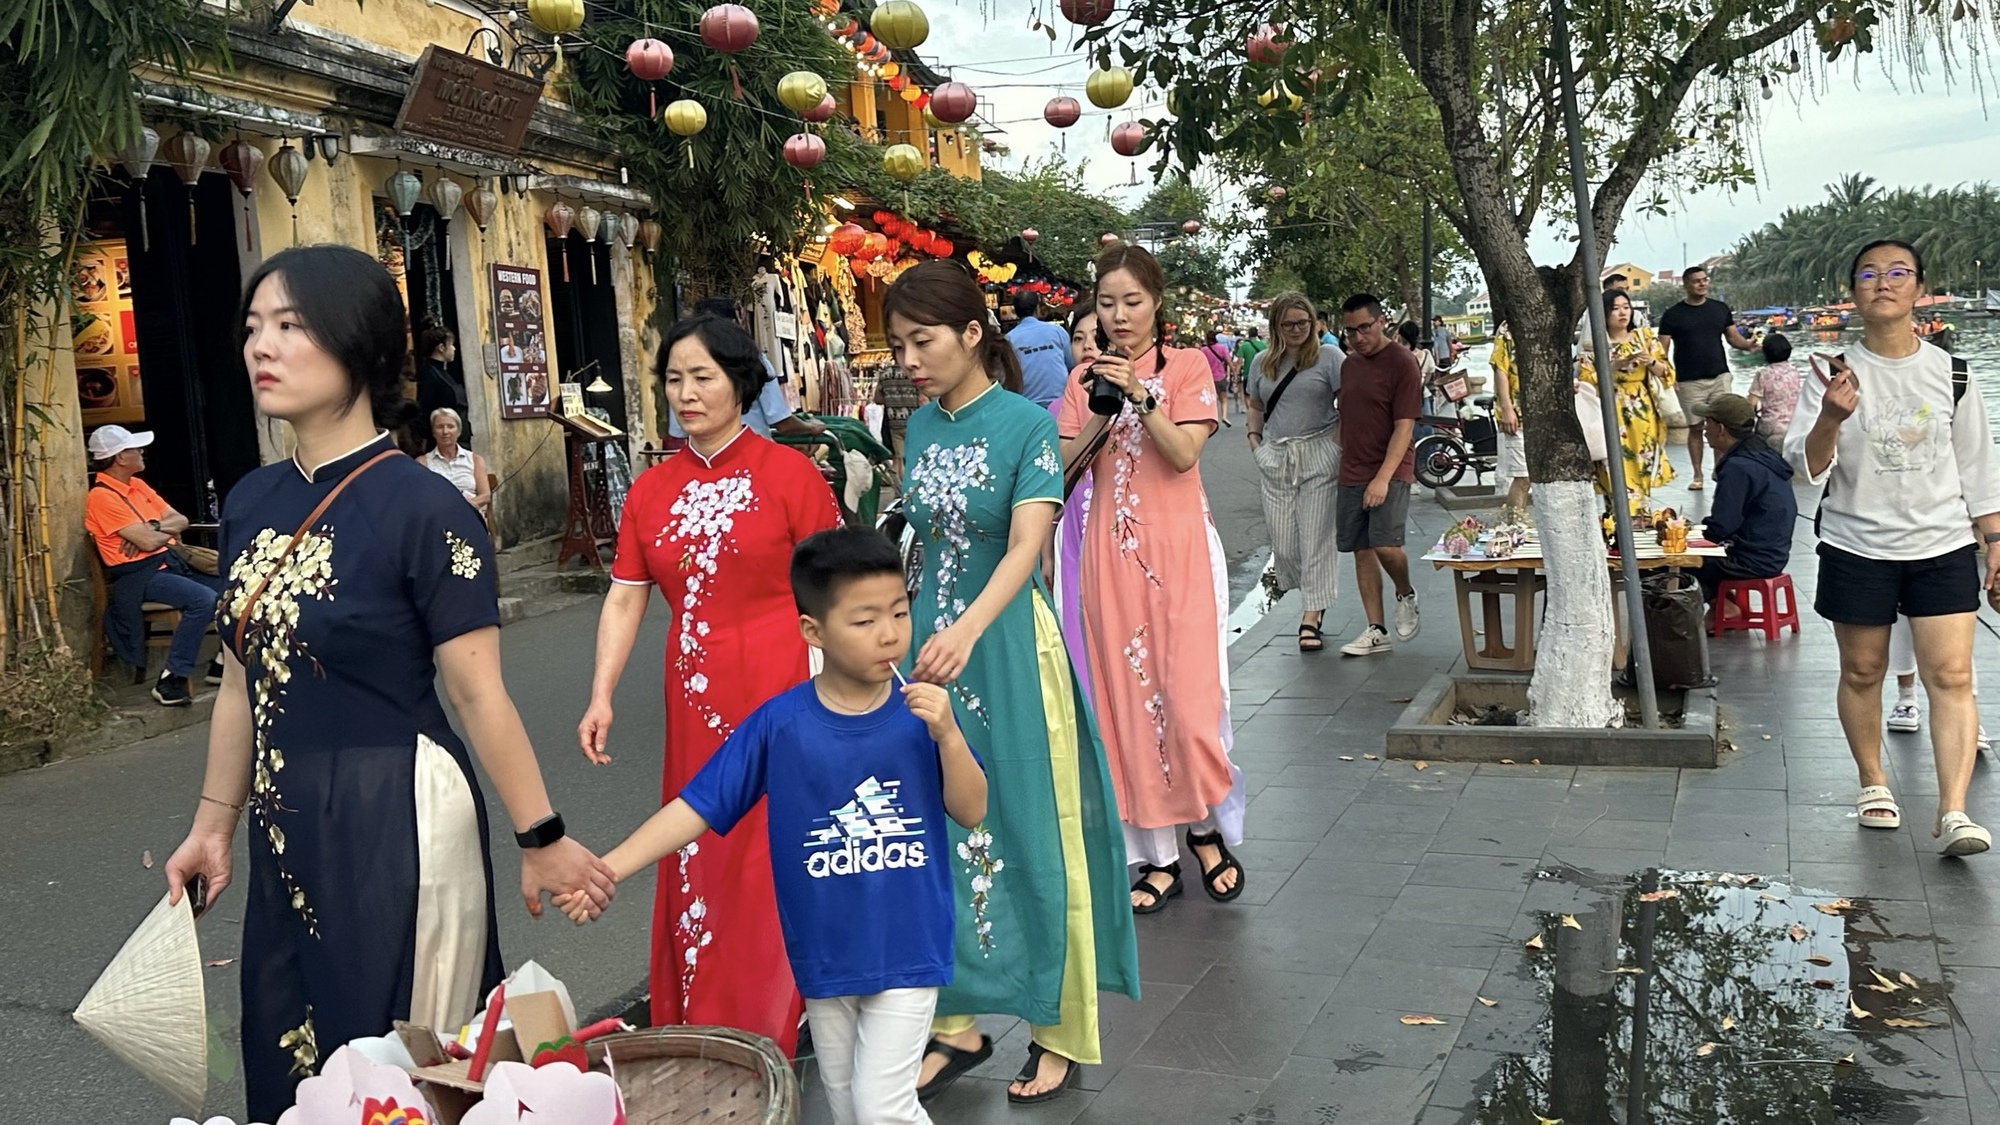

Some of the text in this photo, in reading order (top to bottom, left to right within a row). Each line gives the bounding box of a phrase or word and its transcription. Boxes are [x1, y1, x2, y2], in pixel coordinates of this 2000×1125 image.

[497, 270, 537, 285] WESTERN FOOD
[804, 836, 928, 878] adidas
